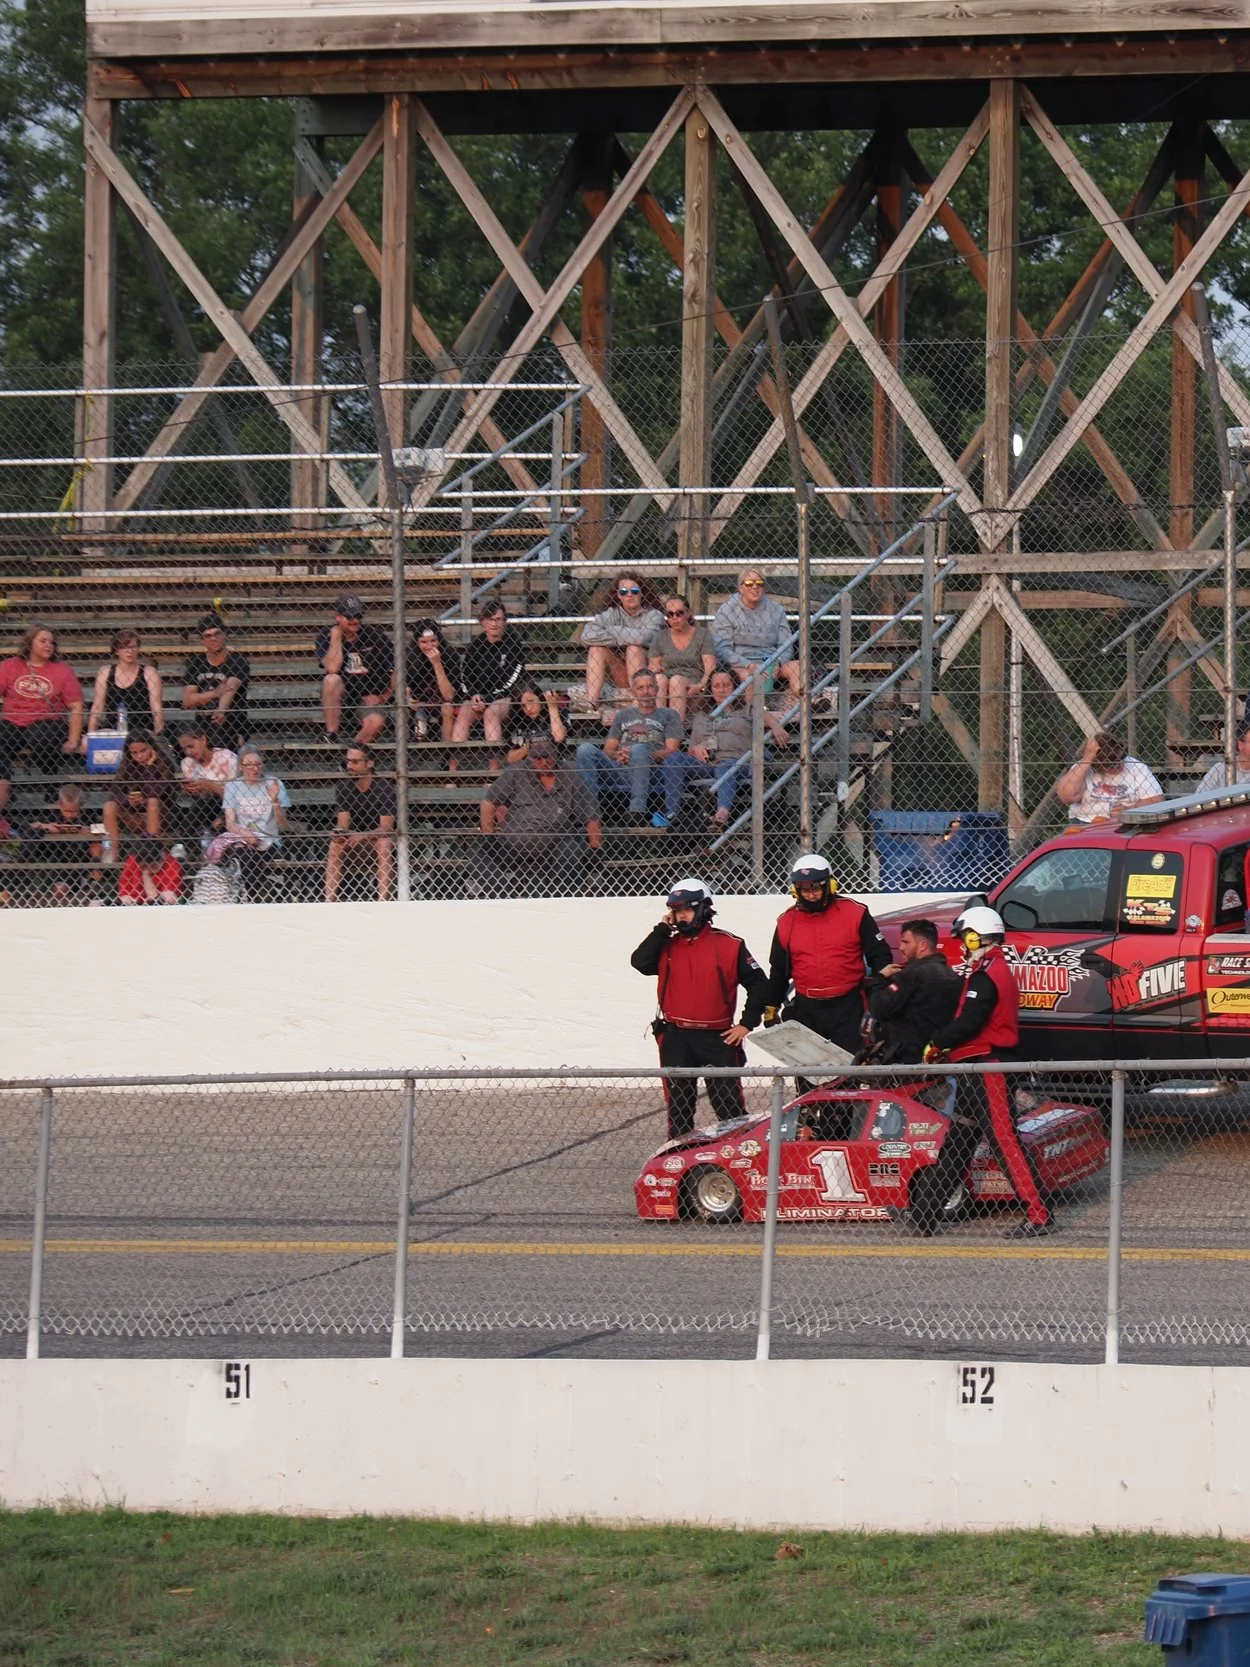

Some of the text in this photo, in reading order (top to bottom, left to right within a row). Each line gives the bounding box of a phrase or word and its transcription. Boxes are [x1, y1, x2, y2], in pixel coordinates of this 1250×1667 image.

[1139, 961, 1186, 999] FIVE
[1222, 957, 1244, 967] RACE
[811, 1150, 867, 1202] 1
[226, 1363, 250, 1399] 51
[962, 1367, 995, 1404] 52
